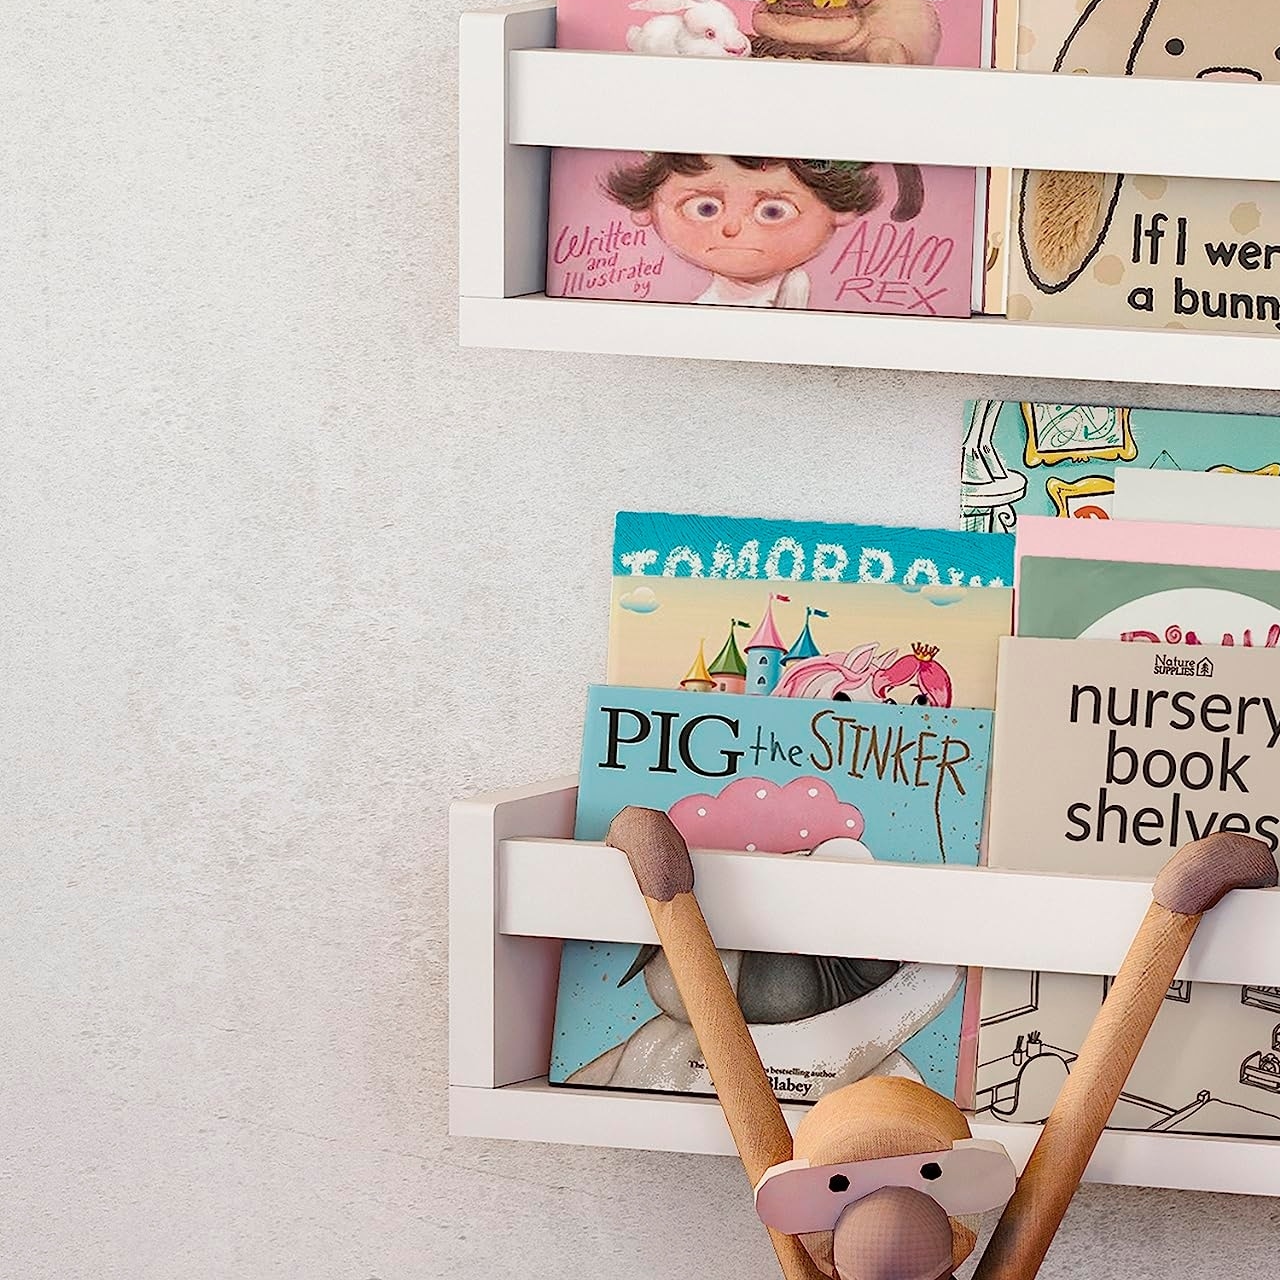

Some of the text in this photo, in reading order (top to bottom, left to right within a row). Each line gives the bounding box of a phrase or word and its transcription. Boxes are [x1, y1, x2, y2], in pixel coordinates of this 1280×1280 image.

[554, 220, 648, 265] Written
[829, 220, 954, 287] ADAM
[1131, 212, 1168, 265] If
[1176, 217, 1187, 266] I
[587, 252, 618, 271] and
[633, 280, 651, 299] by
[834, 277, 948, 315] REX
[1127, 284, 1154, 312] a
[1153, 665, 1195, 677] SUPPLIES
[1154, 654, 1196, 668] Nature
[597, 705, 971, 796] PIG the STINKER
[1104, 729, 1251, 794] book
[687, 1060, 837, 1079] The bestselling author
